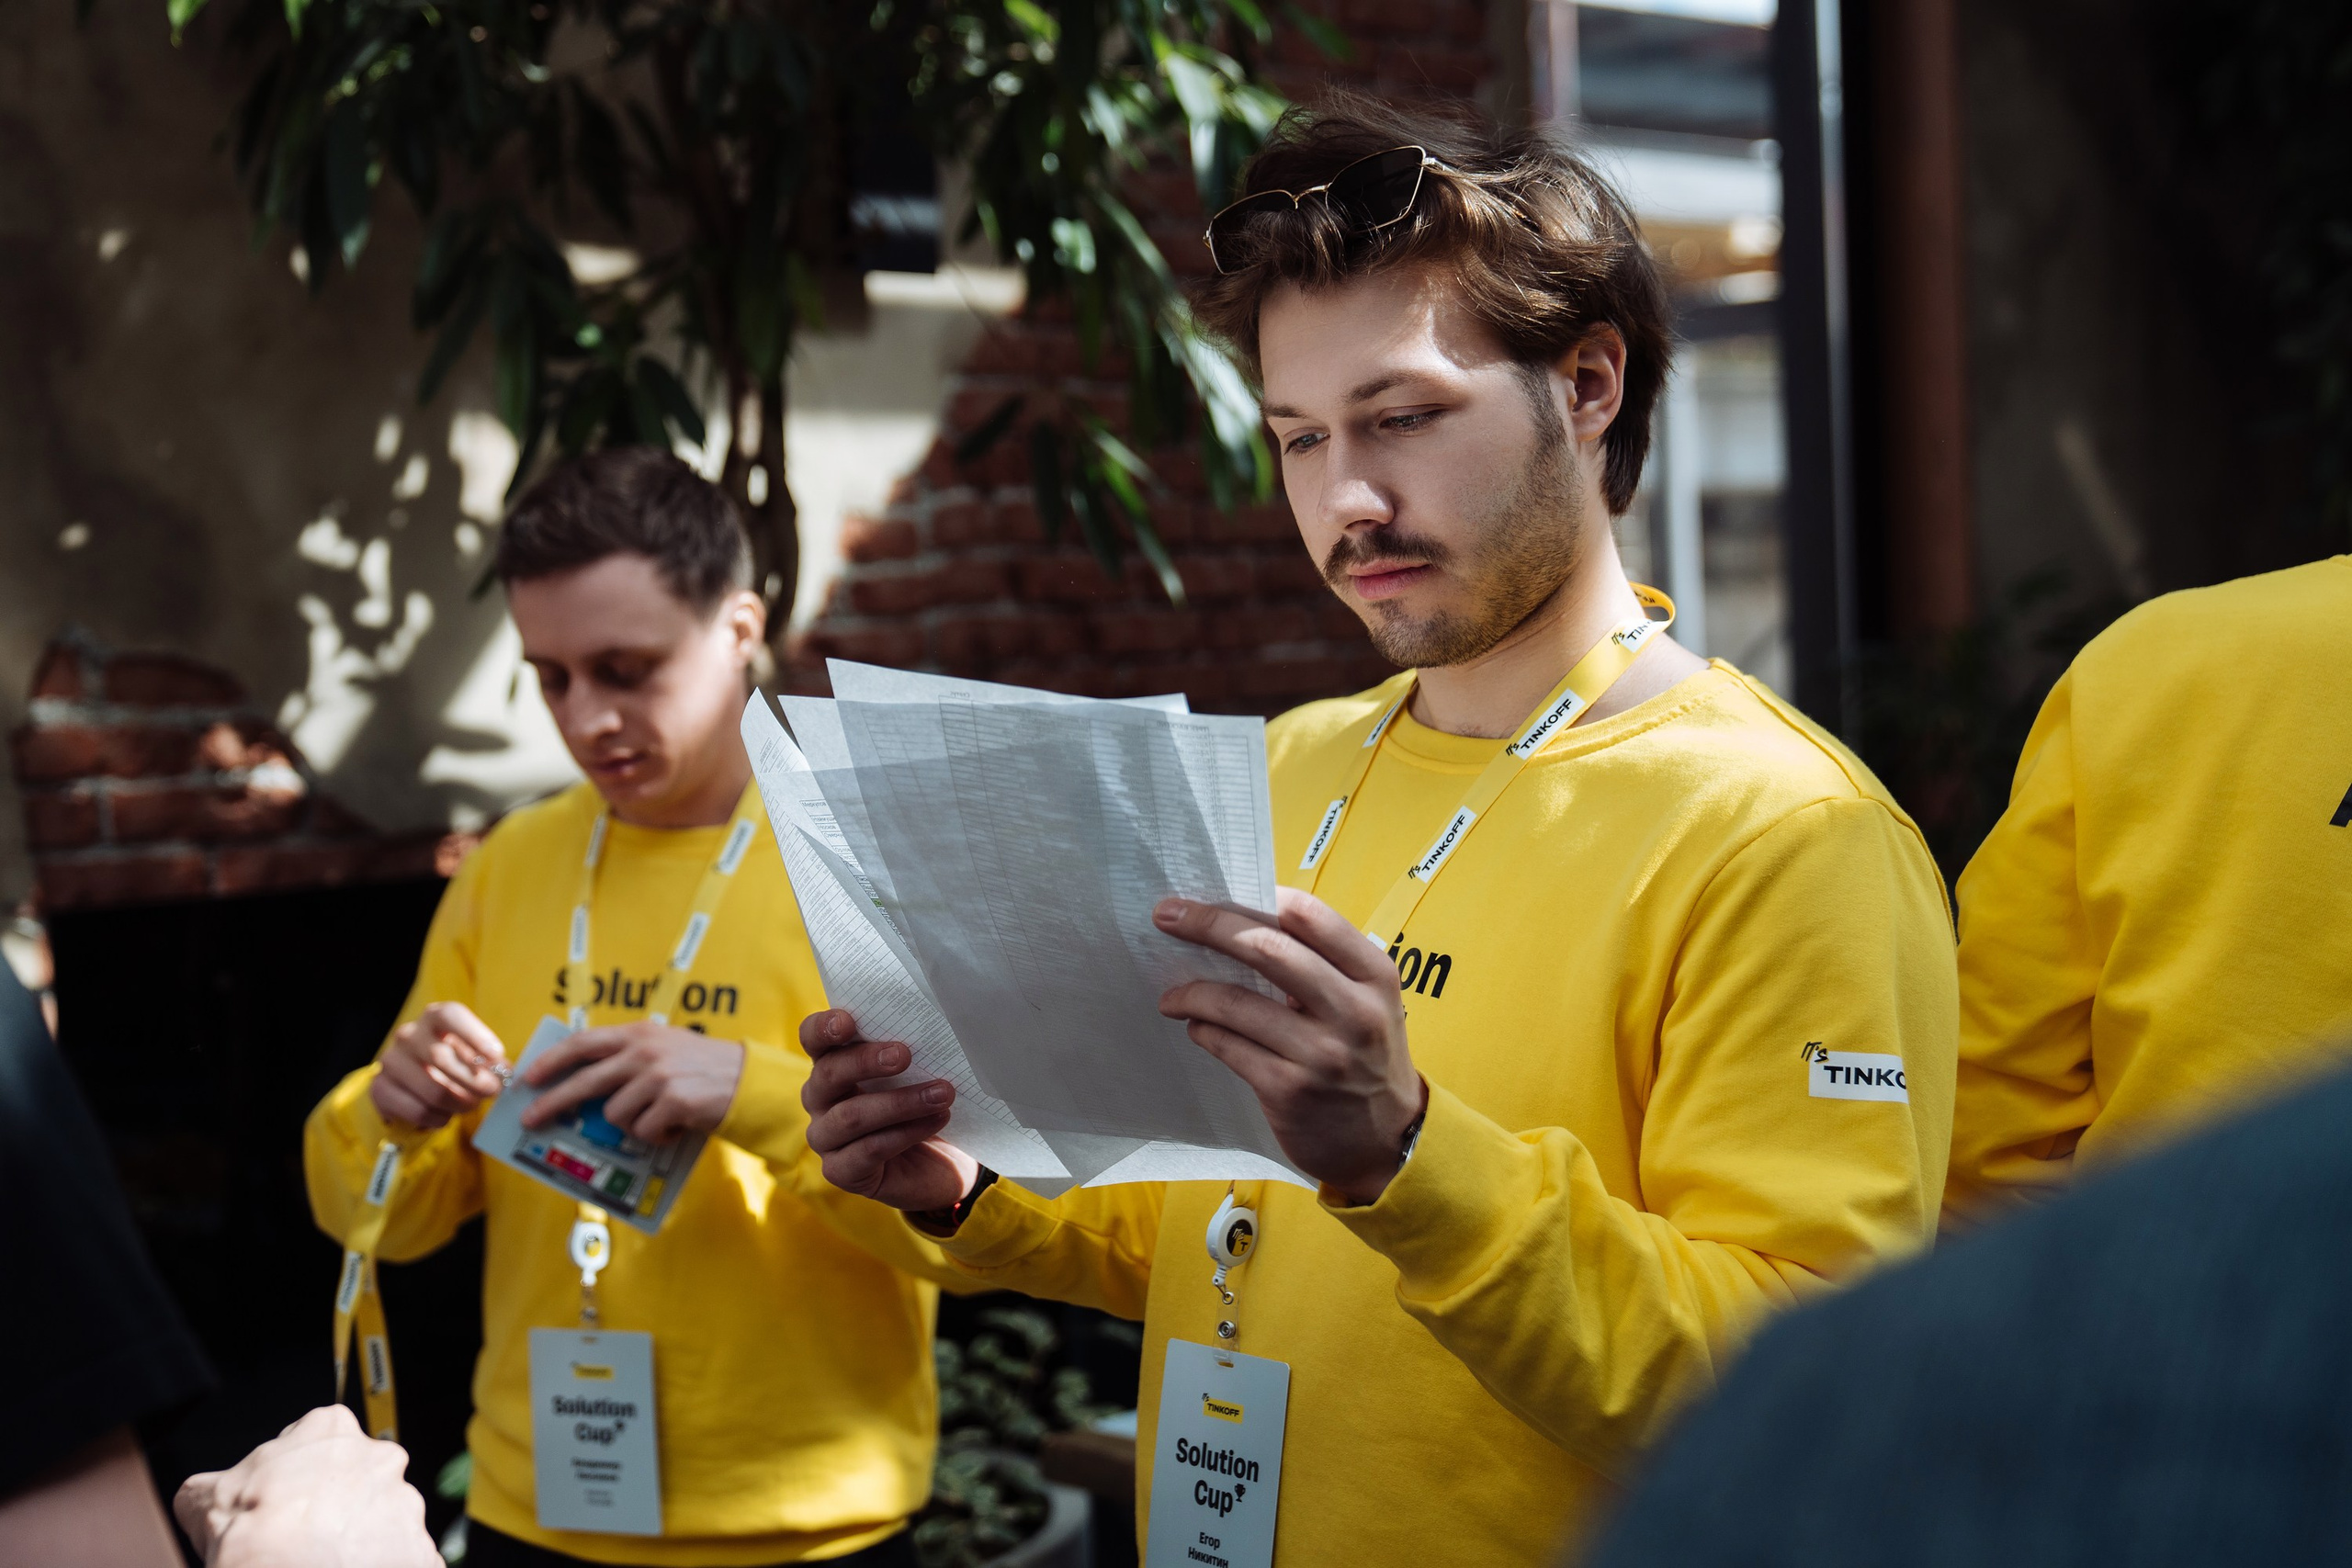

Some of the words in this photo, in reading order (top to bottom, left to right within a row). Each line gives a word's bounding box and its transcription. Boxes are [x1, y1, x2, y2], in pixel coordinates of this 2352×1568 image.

[1521, 698, 1572, 750] TINKOFF
[1307, 807, 1338, 863] TINKOFF
[1421, 814, 1465, 872] TINKOFF
[1824, 1065, 1907, 1090] TINKO
[1240, 1241, 1248, 1251] T
[552, 1395, 637, 1417] Solution
[1206, 1403, 1240, 1417] TINKOFF
[573, 1422, 615, 1446] Cup
[1175, 1438, 1260, 1483] Solution
[1194, 1479, 1234, 1517] Cup
[1199, 1531, 1221, 1551] Егор
[1188, 1546, 1229, 1568] Никитин
